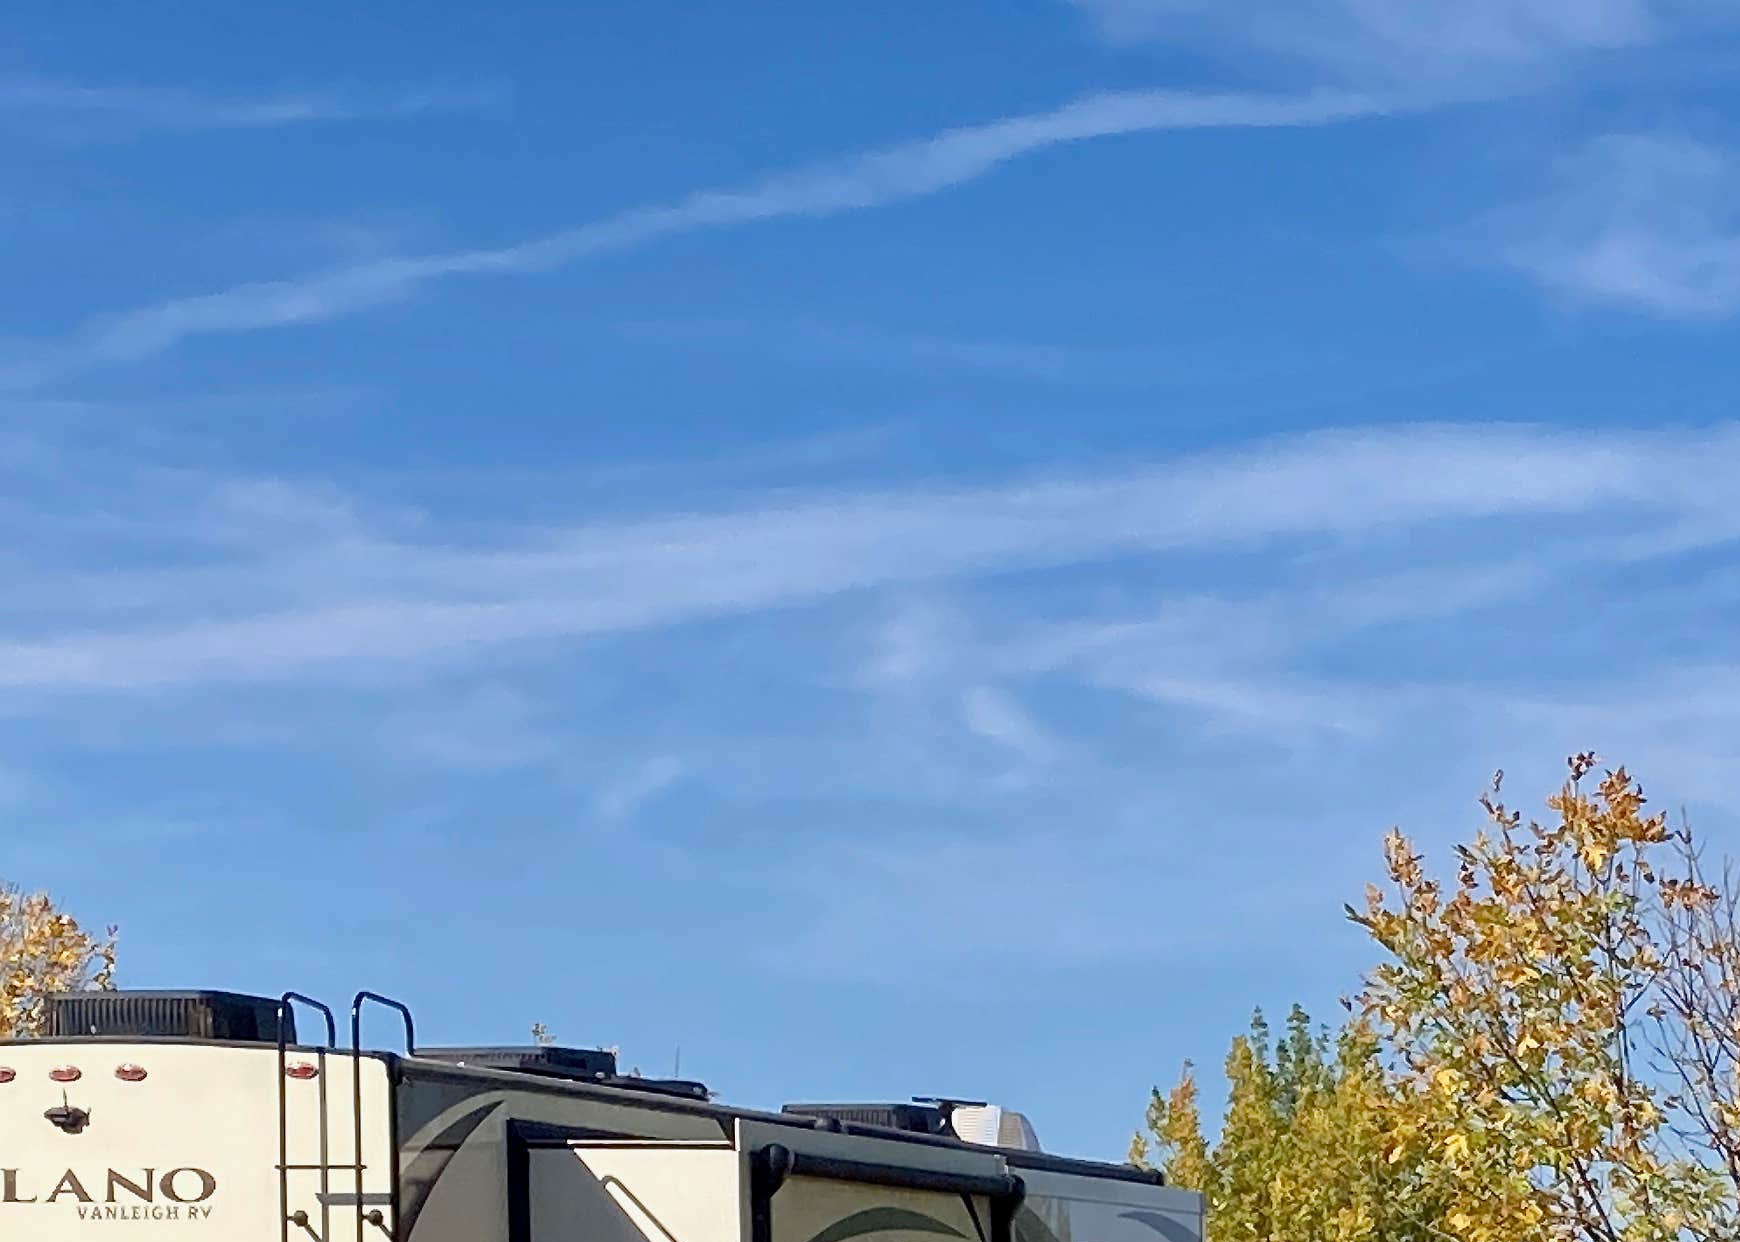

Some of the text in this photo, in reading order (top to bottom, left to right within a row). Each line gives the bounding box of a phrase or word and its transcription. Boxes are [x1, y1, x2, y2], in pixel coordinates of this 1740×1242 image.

[0, 1168, 216, 1203] LANO
[76, 1205, 214, 1221] VANLEIGH RV
